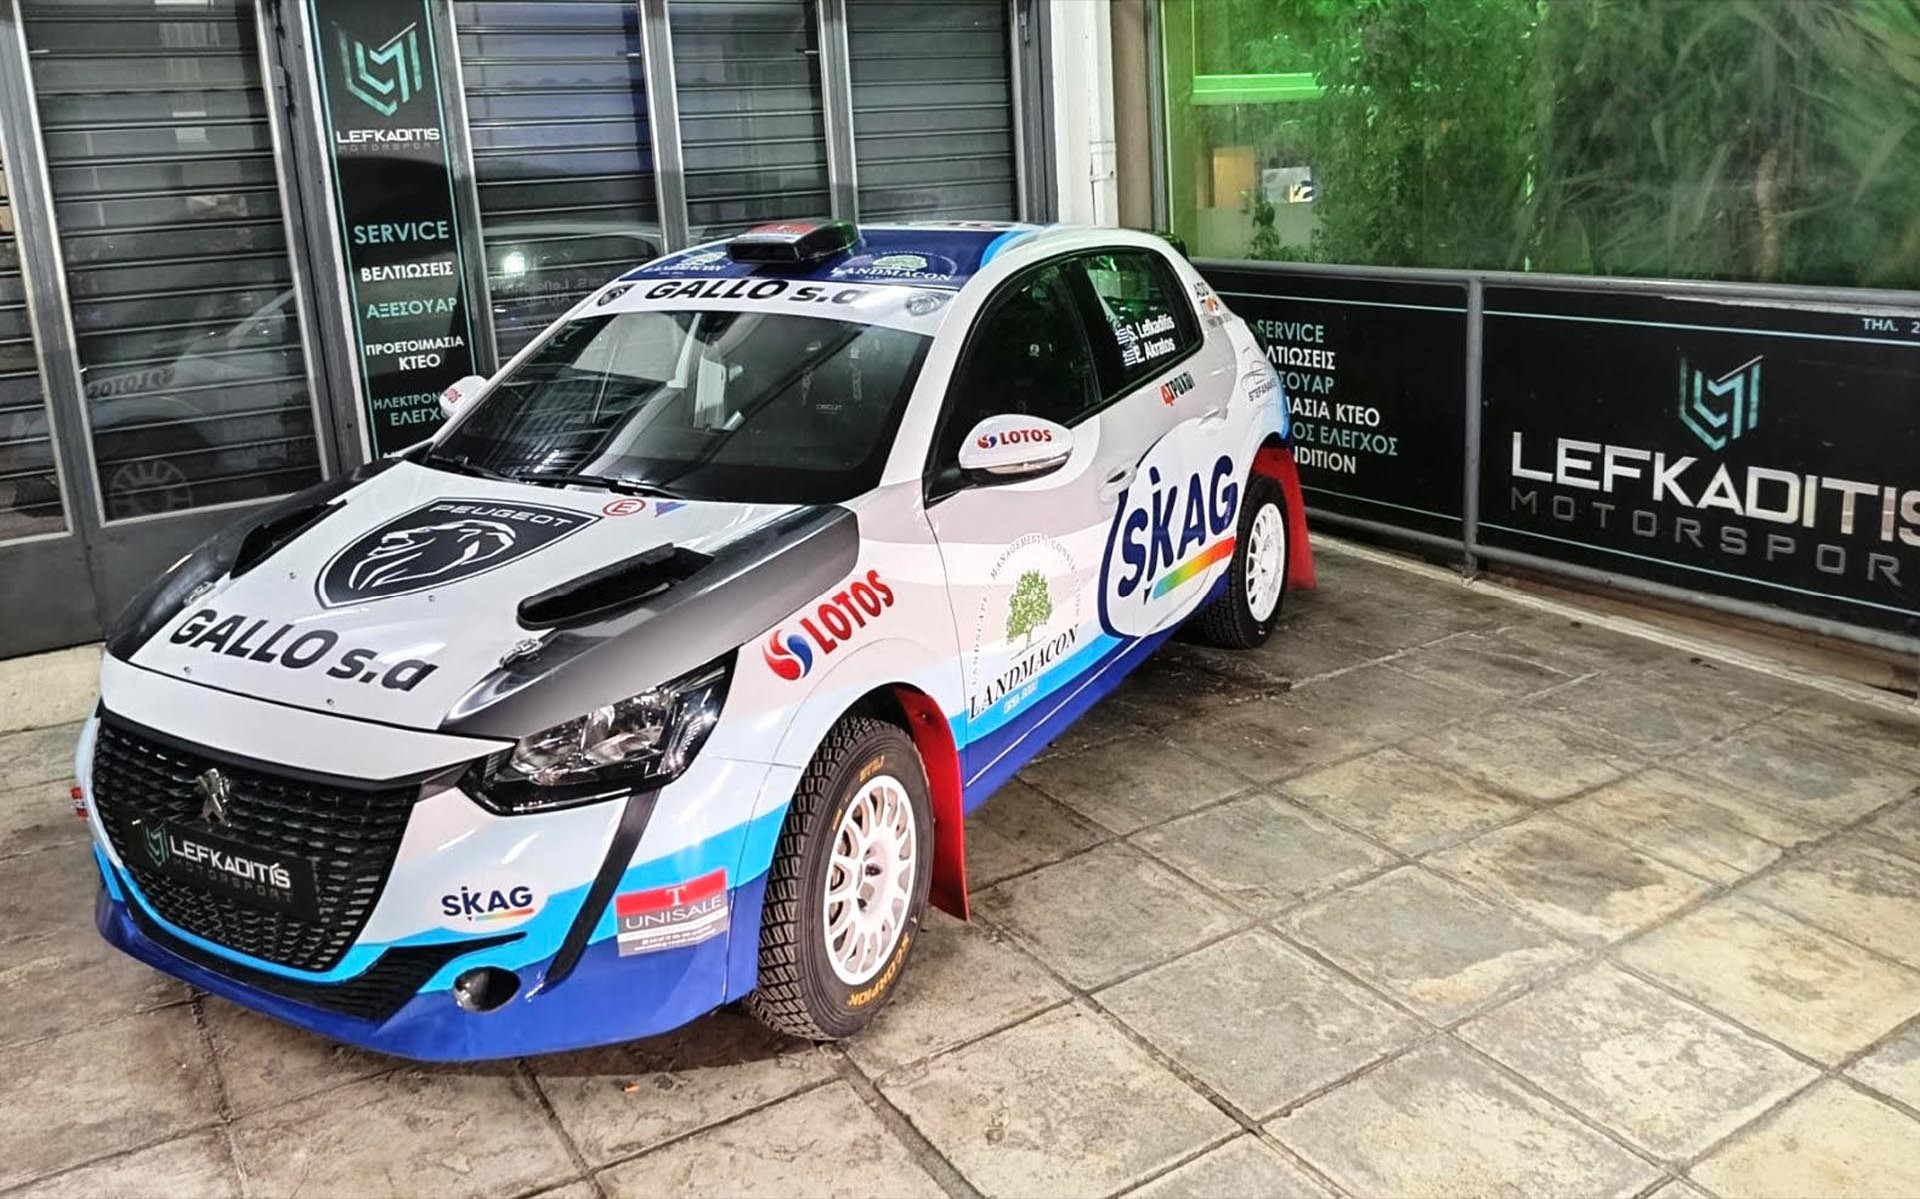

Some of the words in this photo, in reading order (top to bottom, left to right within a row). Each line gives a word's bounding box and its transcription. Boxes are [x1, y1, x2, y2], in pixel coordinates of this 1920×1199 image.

[336, 128, 440, 144] LEFKADITIS
[338, 141, 440, 152] MOTORSPORT
[353, 220, 450, 245] SERVICE
[360, 261, 454, 282] ΒΕΛΤΙΩΣΕΙΣ
[644, 280, 789, 300] GALLO
[366, 297, 457, 320] ΑΞΕΣΟΥΑΡ
[1257, 319, 1324, 344] SERVICE
[366, 336, 464, 357] ΠΡΟΕΤΟΙΜΑΣΙΑ
[1266, 345, 1336, 370] ΛΤΙΩΣΕΙΣ
[398, 353, 441, 371] ΚΤΕΟ
[1278, 371, 1334, 394] ΣΟΥΑΡ
[373, 392, 441, 410] ΗΛΕΚΤΡΟΝ
[1336, 403, 1380, 427] ΚΤΕΟ
[1000, 429, 1052, 445] LOTOS
[1320, 427, 1398, 456] ΕΛΕΓΧΟΣ
[1294, 445, 1356, 474] DITION
[429, 504, 573, 526] PEUGEOT
[1511, 487, 1902, 587] MOTORSPOR
[800, 569, 894, 655] LOTOS
[169, 609, 339, 669] GALLO
[325, 648, 439, 691] s.a
[968, 623, 1080, 720] LANDMACON
[441, 886, 533, 917] SKAG
[626, 894, 721, 929] UNISALE
